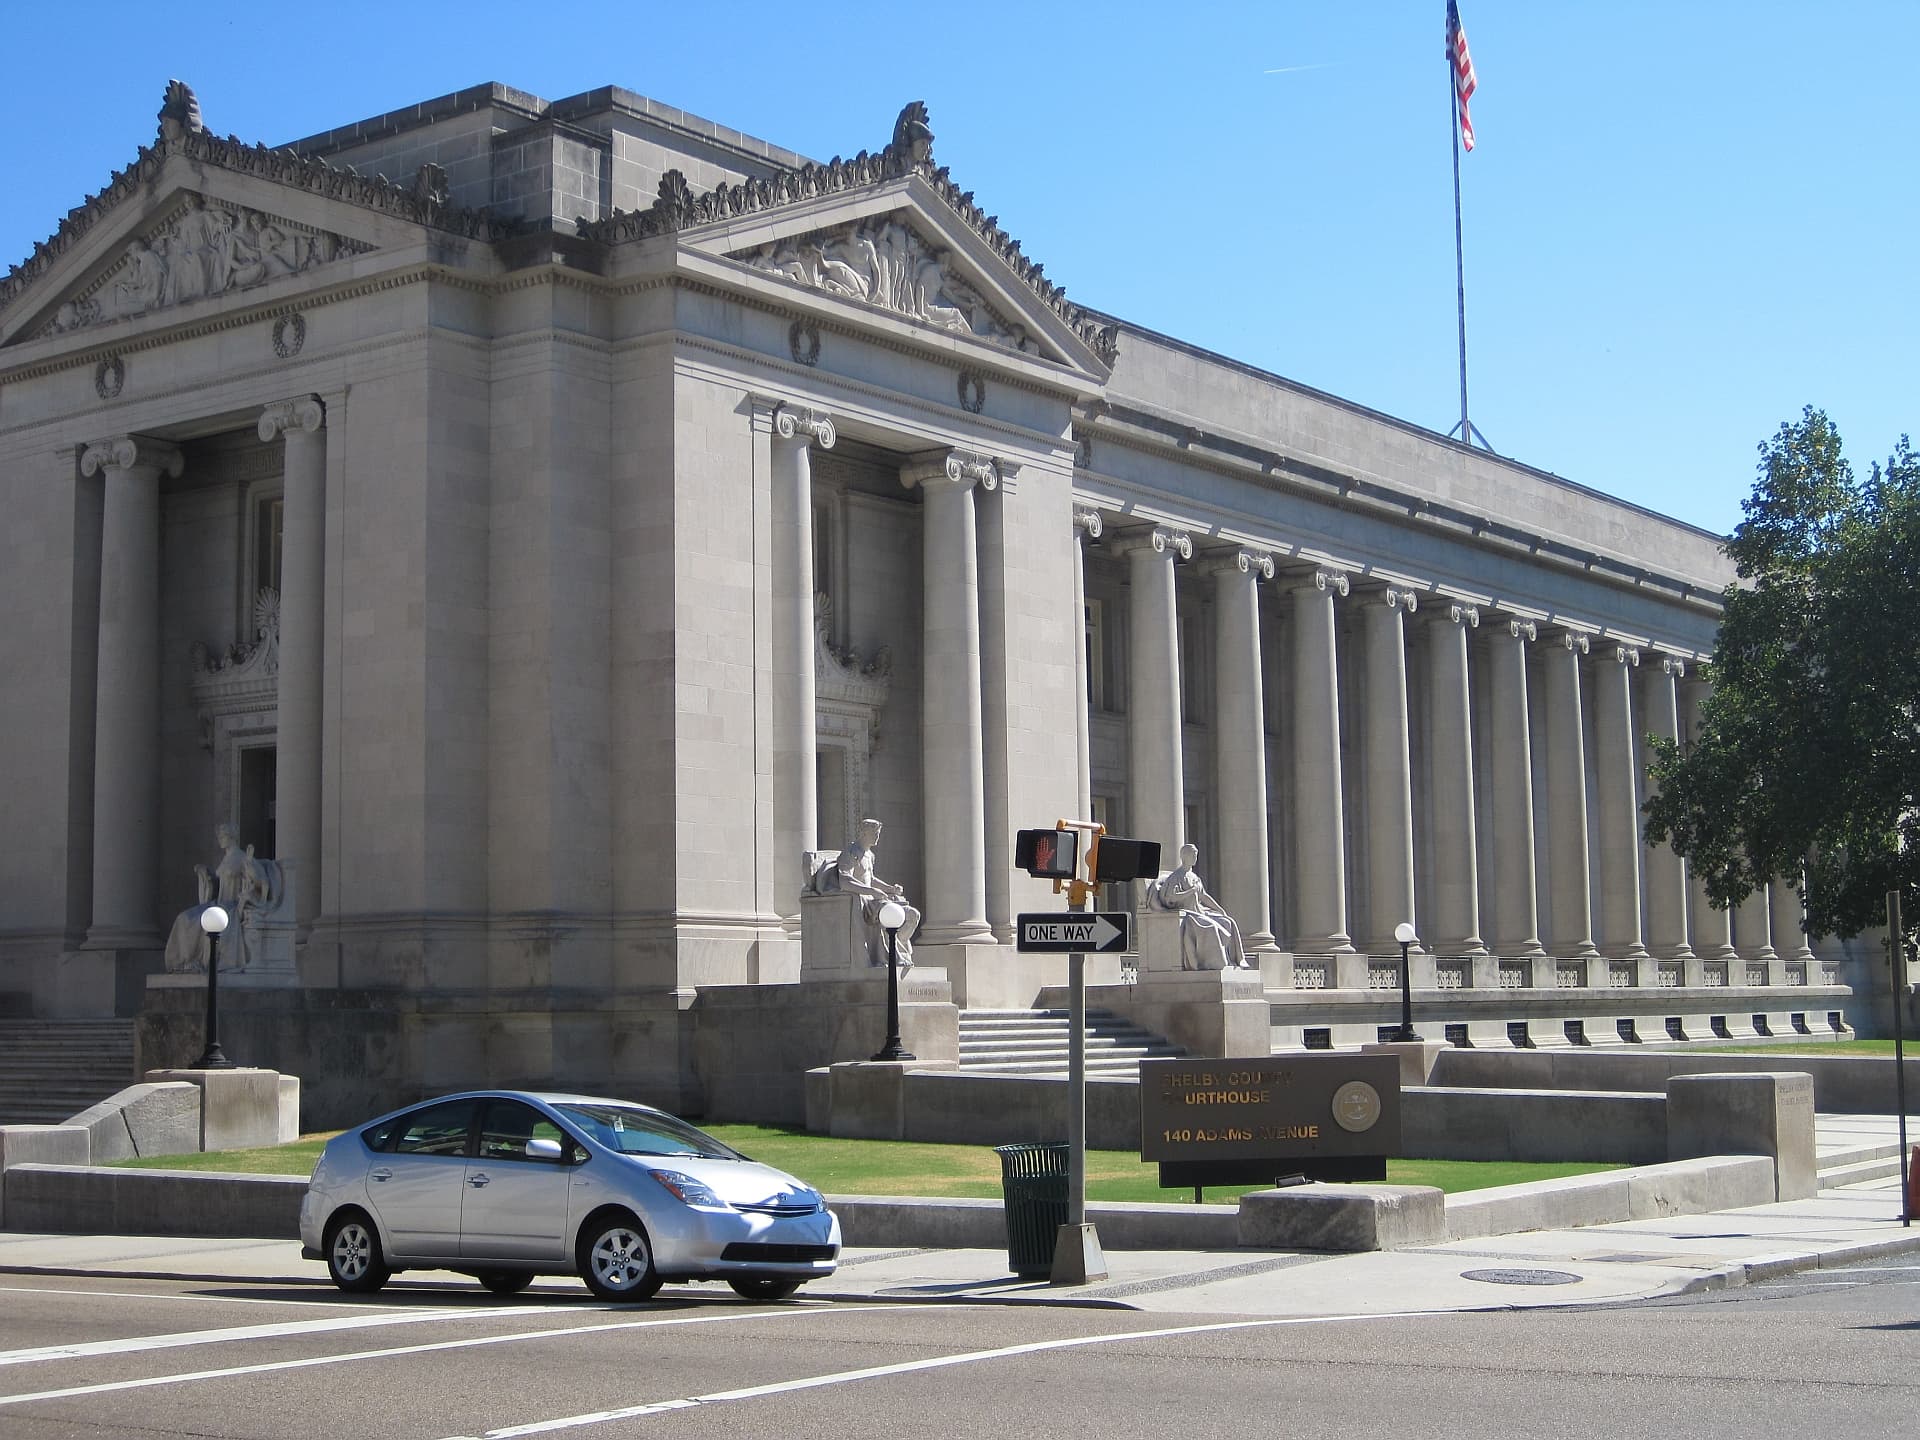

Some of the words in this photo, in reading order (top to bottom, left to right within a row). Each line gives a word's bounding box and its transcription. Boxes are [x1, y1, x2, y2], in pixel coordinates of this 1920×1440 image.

[1029, 925, 1057, 940] ONE
[1063, 925, 1094, 940] WAY
[1162, 1090, 1271, 1105] URTHOUSE
[1163, 1129, 1191, 1143] 140
[1195, 1127, 1253, 1142] ADAMS
